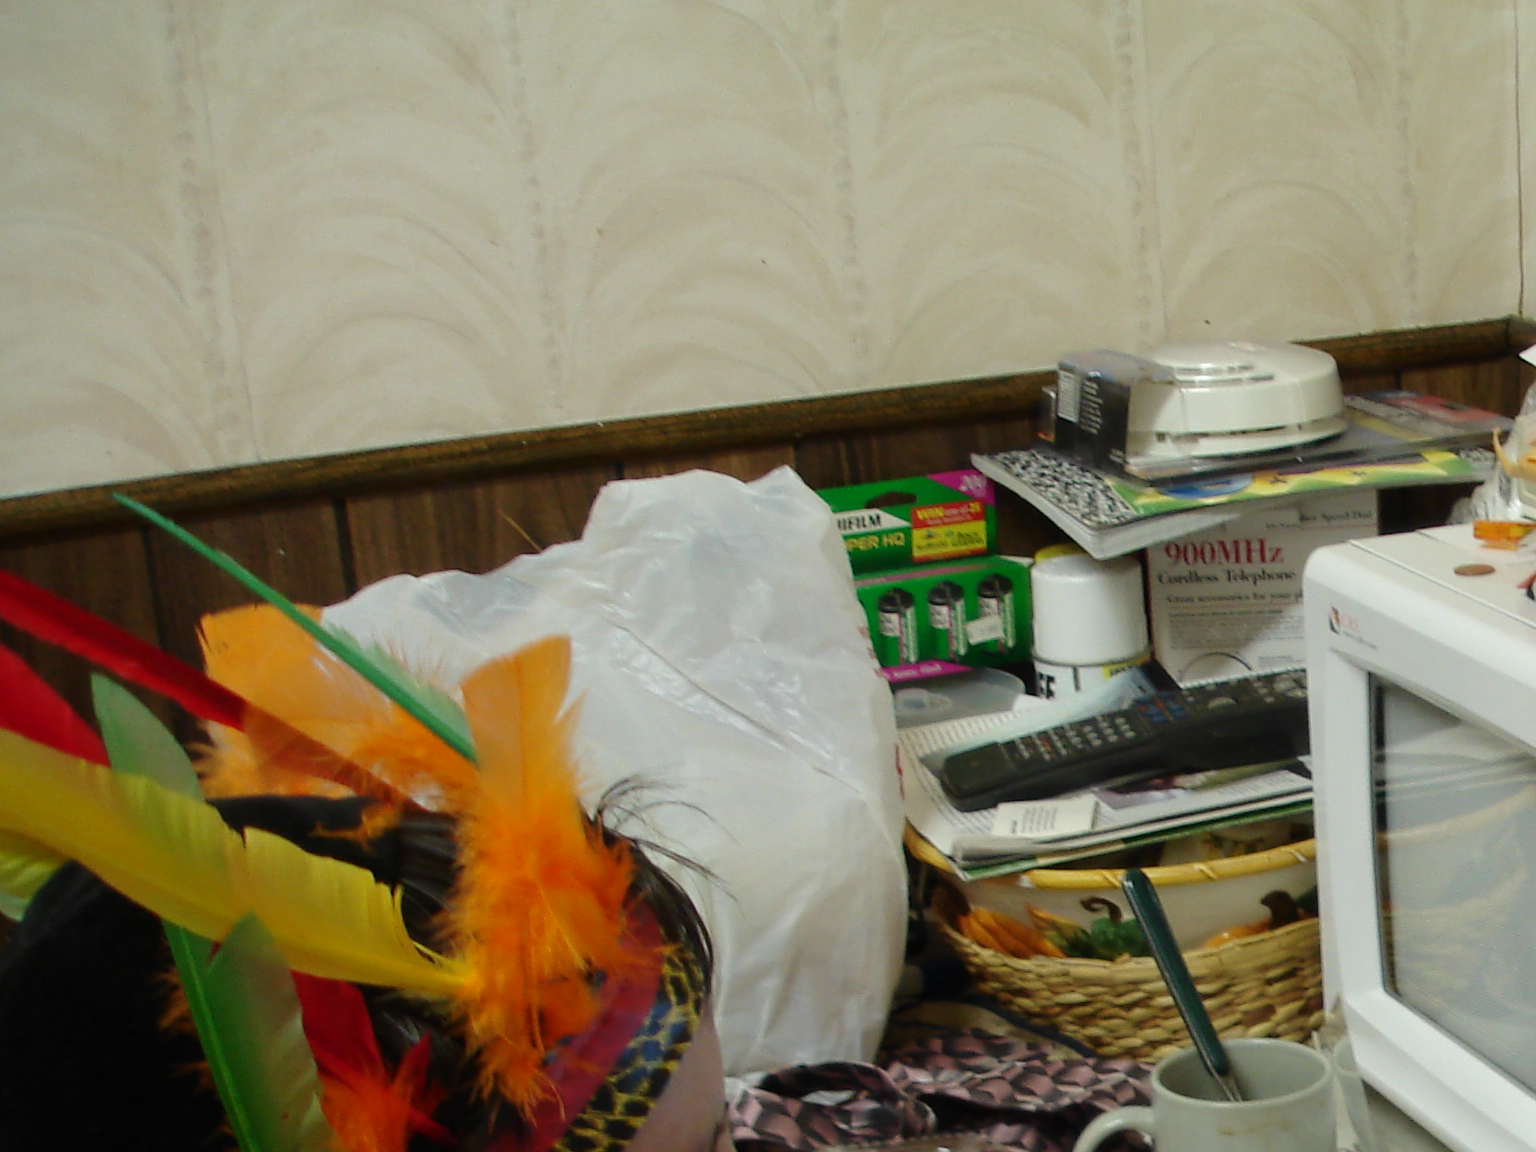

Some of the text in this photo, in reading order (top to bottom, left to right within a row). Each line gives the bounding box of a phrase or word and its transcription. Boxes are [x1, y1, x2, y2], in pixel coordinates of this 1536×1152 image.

[882, 531, 906, 548] HQ
[1164, 537, 1284, 566] 900MHz
[1157, 567, 1298, 587] Cordless Telephone
